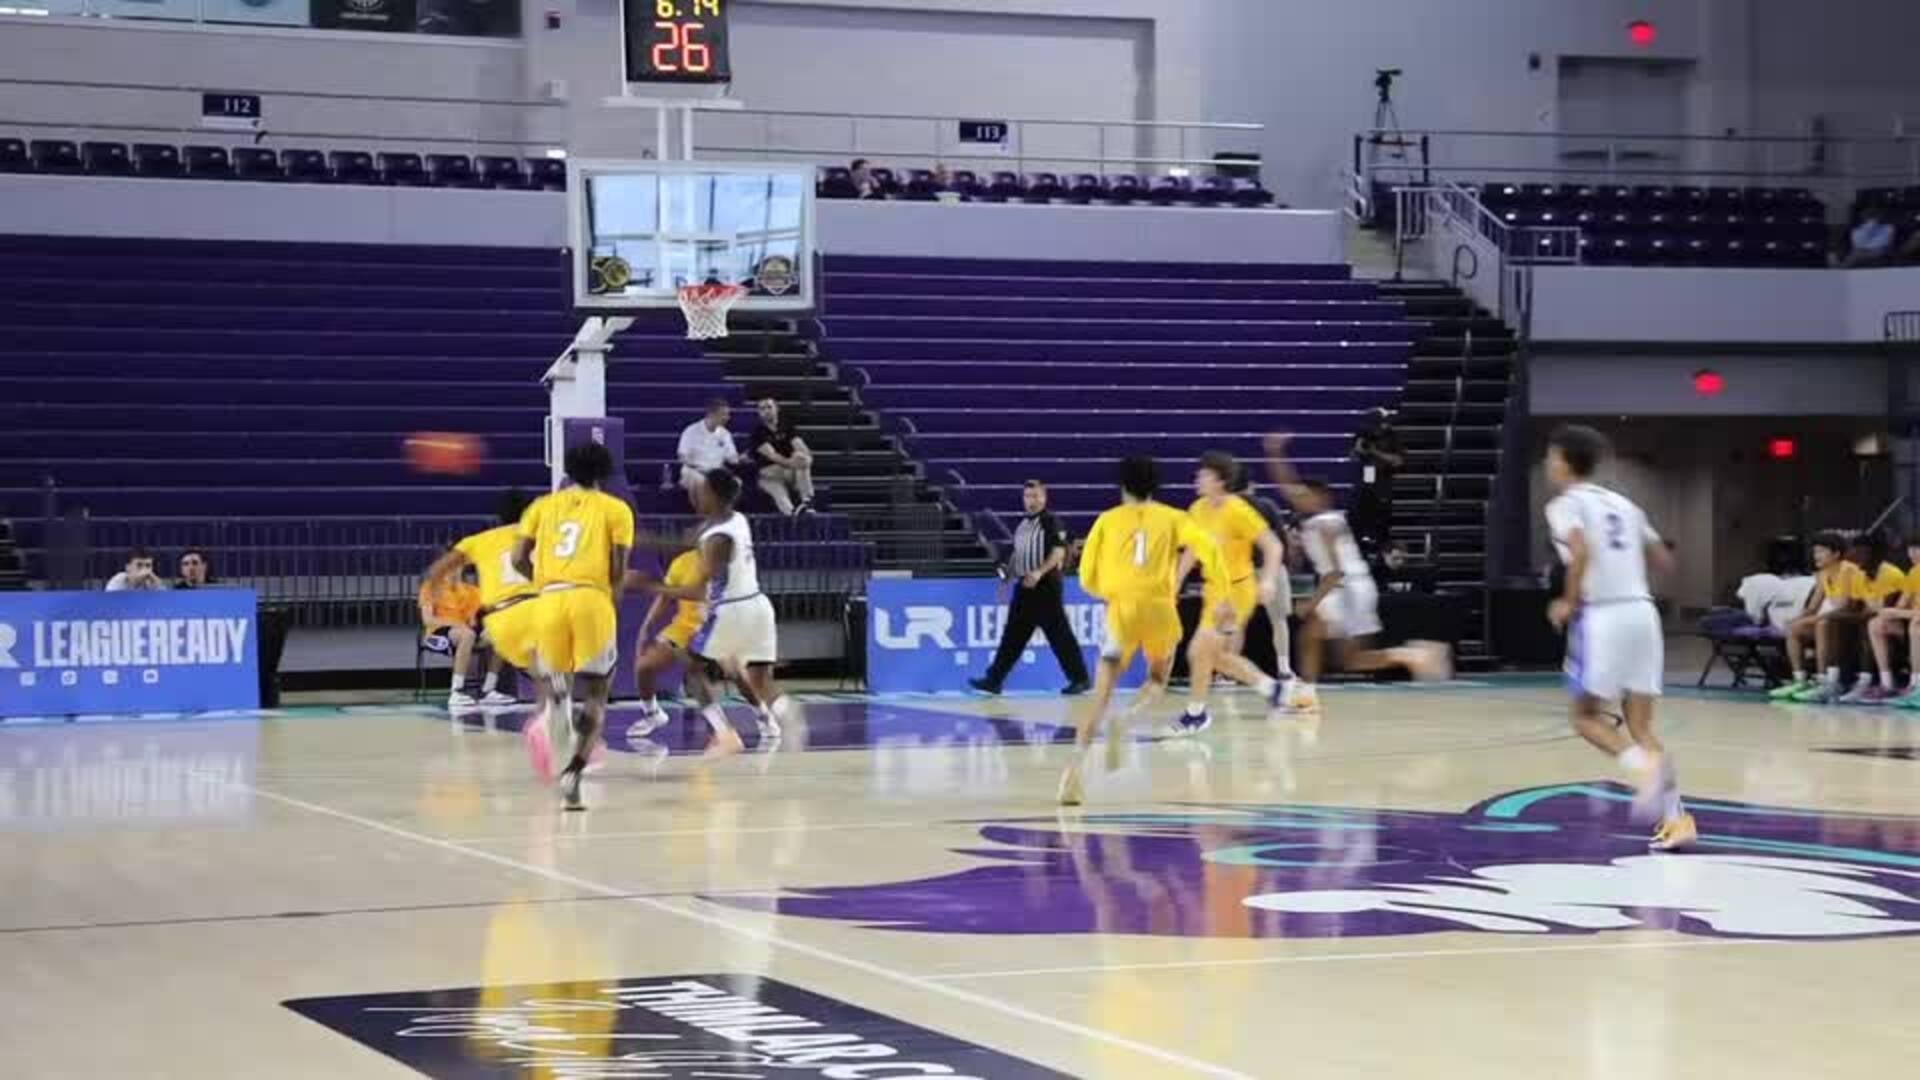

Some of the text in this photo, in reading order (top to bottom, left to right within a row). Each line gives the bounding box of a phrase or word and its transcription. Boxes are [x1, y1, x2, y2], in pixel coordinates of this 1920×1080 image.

[653, 22, 709, 71] 26
[224, 98, 251, 113] 112
[554, 521, 581, 557] 3
[1133, 530, 1147, 566] 1
[34, 618, 248, 667] LEAGUEREADY
